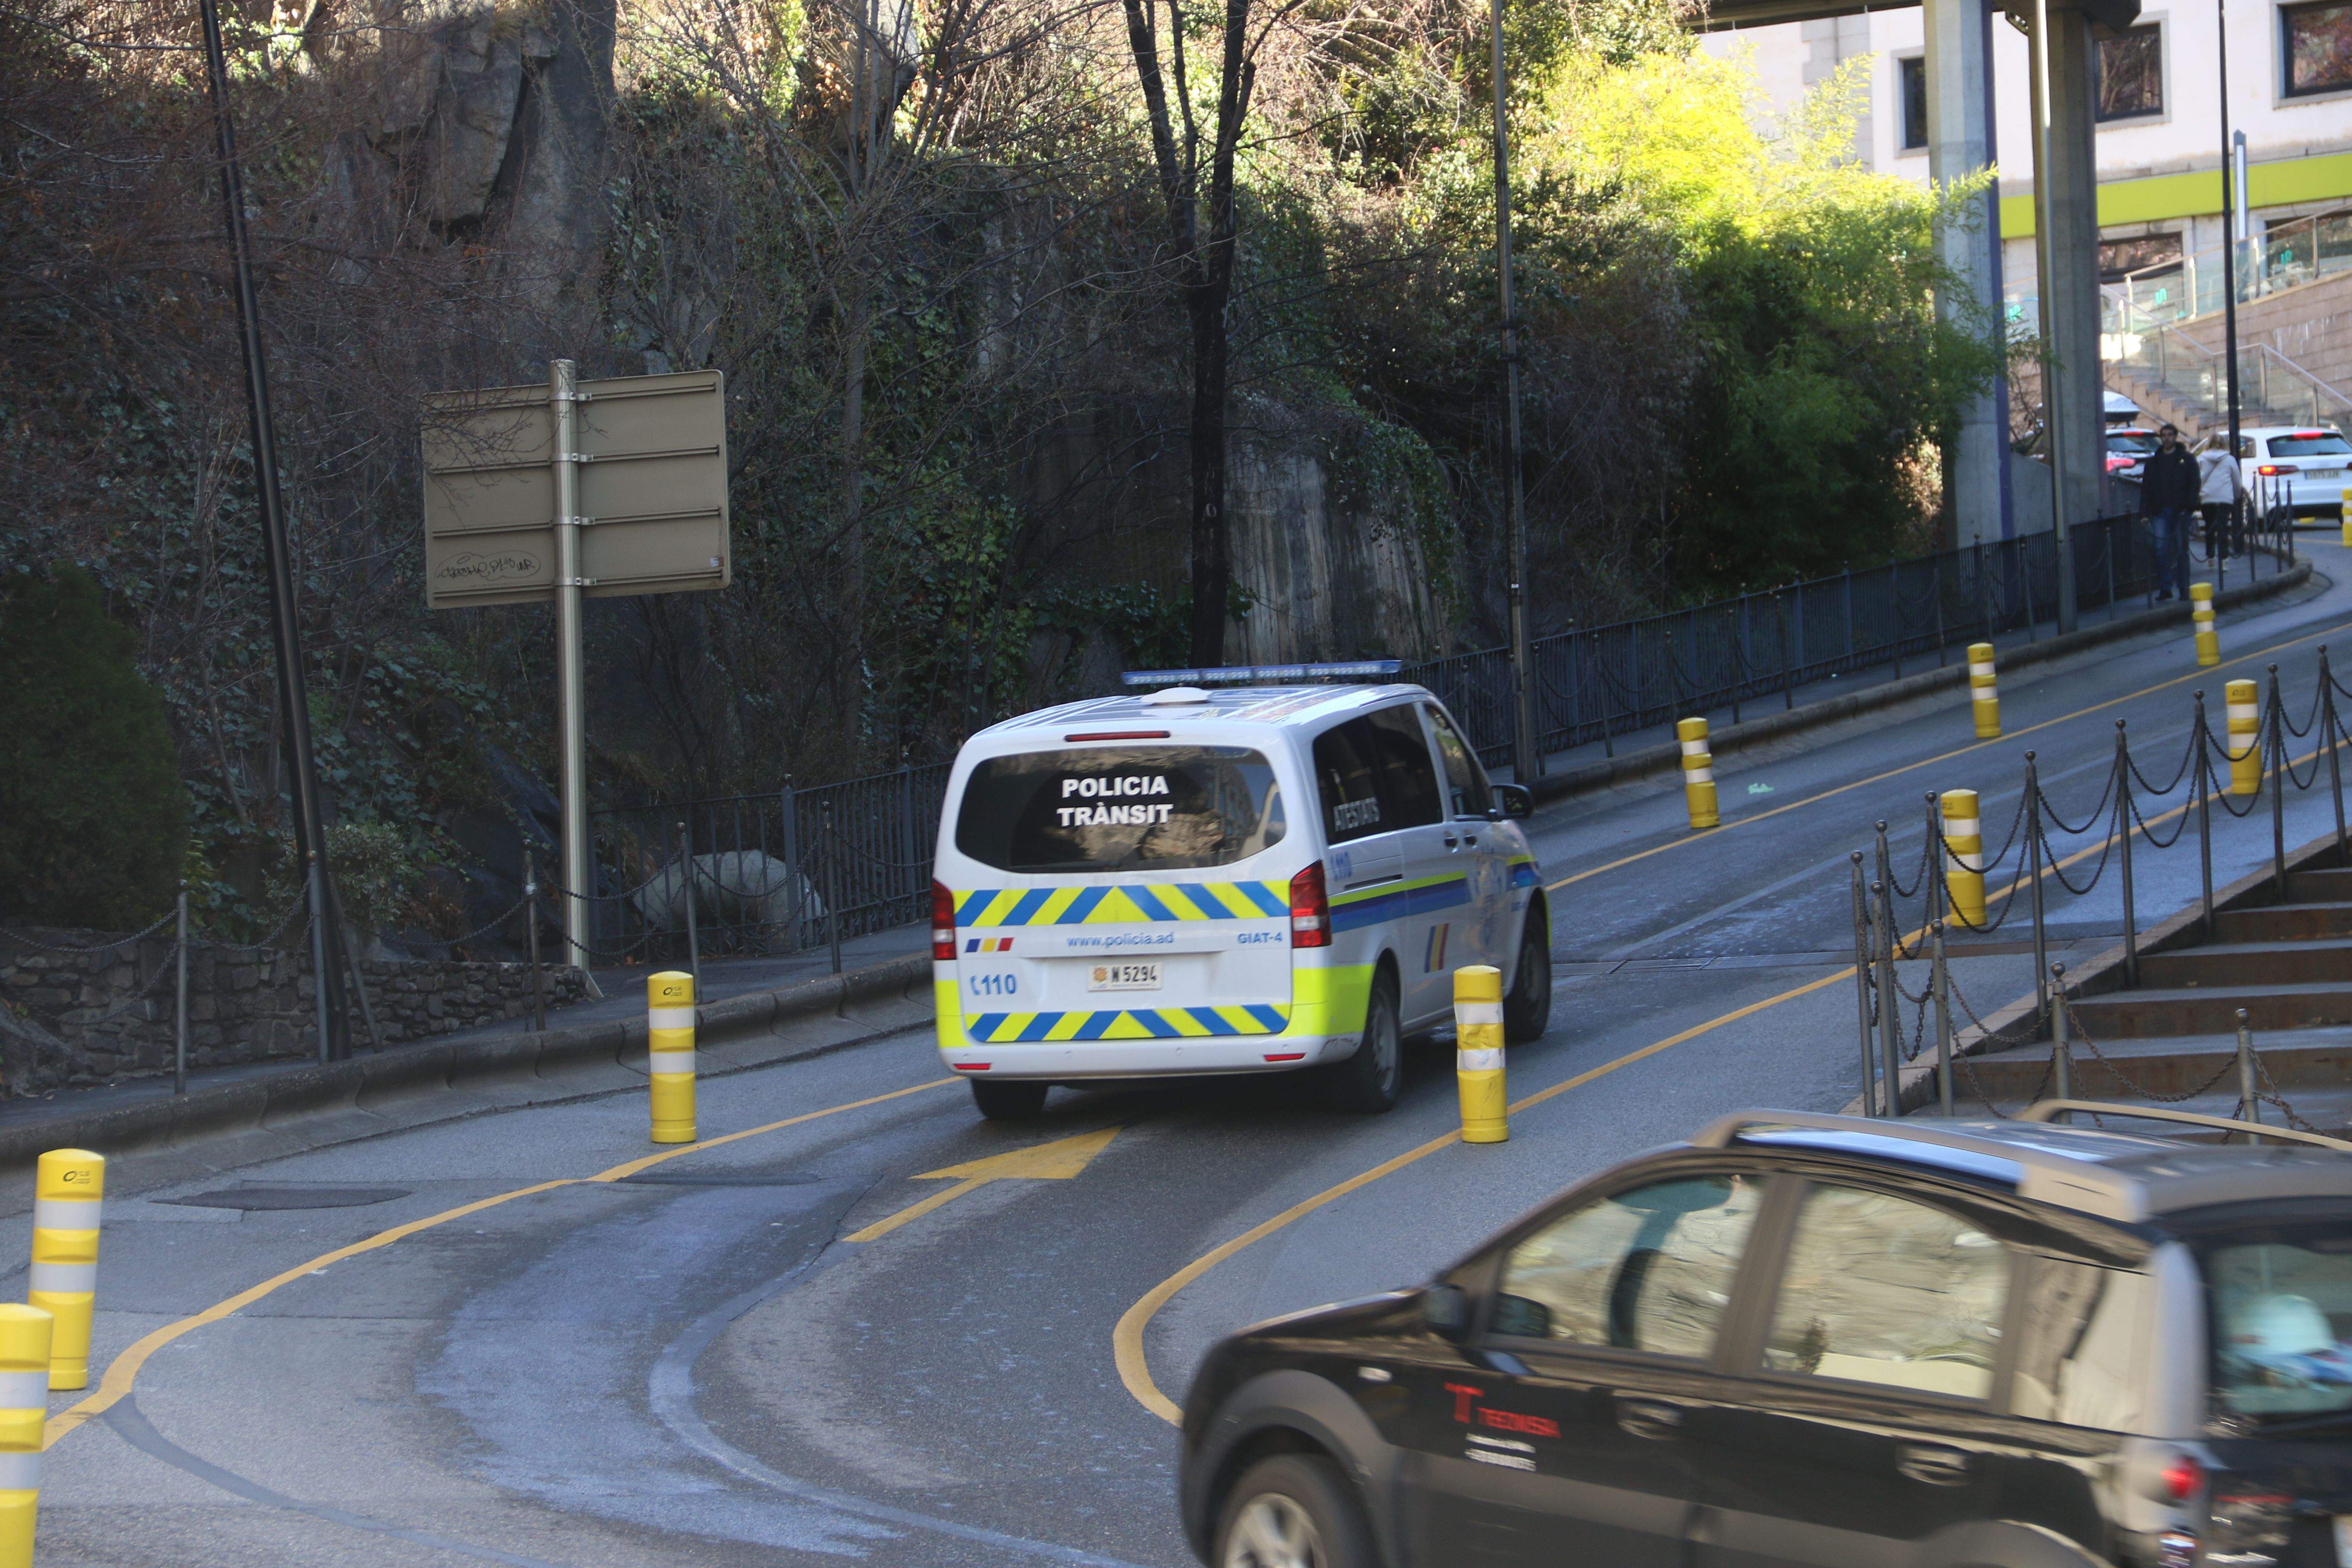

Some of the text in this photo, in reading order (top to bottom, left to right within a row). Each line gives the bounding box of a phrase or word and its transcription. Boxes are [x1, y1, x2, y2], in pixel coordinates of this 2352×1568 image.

[1062, 775, 1170, 799] POLICIA
[1056, 802, 1174, 827] TRÀNSIT
[1067, 931, 1174, 949] www.policia.ad
[1238, 931, 1283, 943] GIAT-4
[1123, 965, 1157, 982] 5294
[980, 974, 1017, 995] 110
